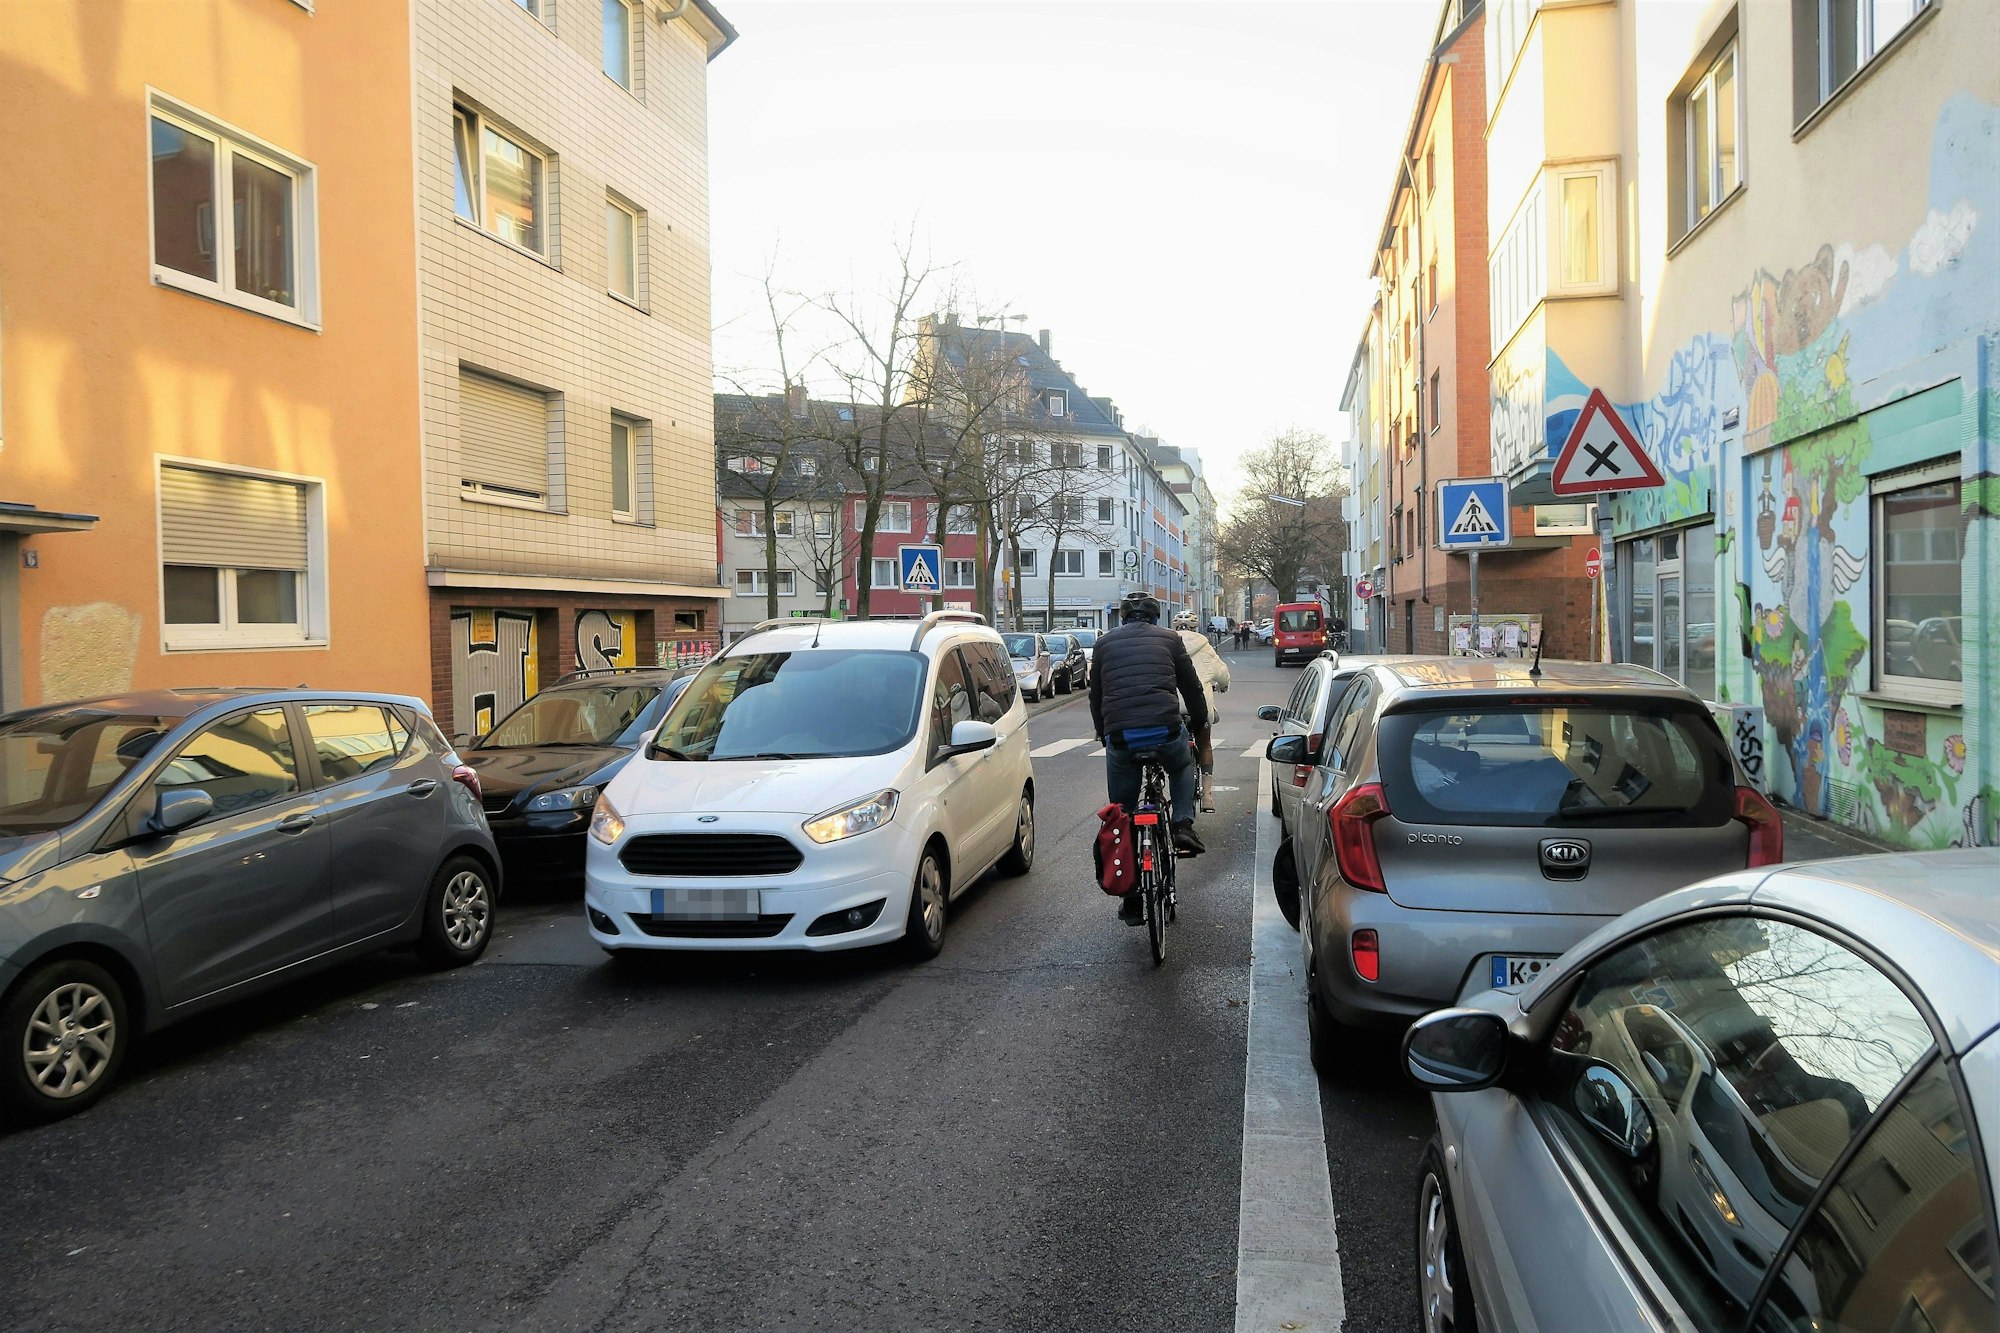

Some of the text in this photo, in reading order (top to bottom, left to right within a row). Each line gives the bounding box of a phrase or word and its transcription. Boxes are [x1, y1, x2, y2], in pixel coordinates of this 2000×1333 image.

[1407, 831, 1463, 846] picanto
[1551, 847, 1580, 860] KIA
[1496, 975, 1503, 984] D
